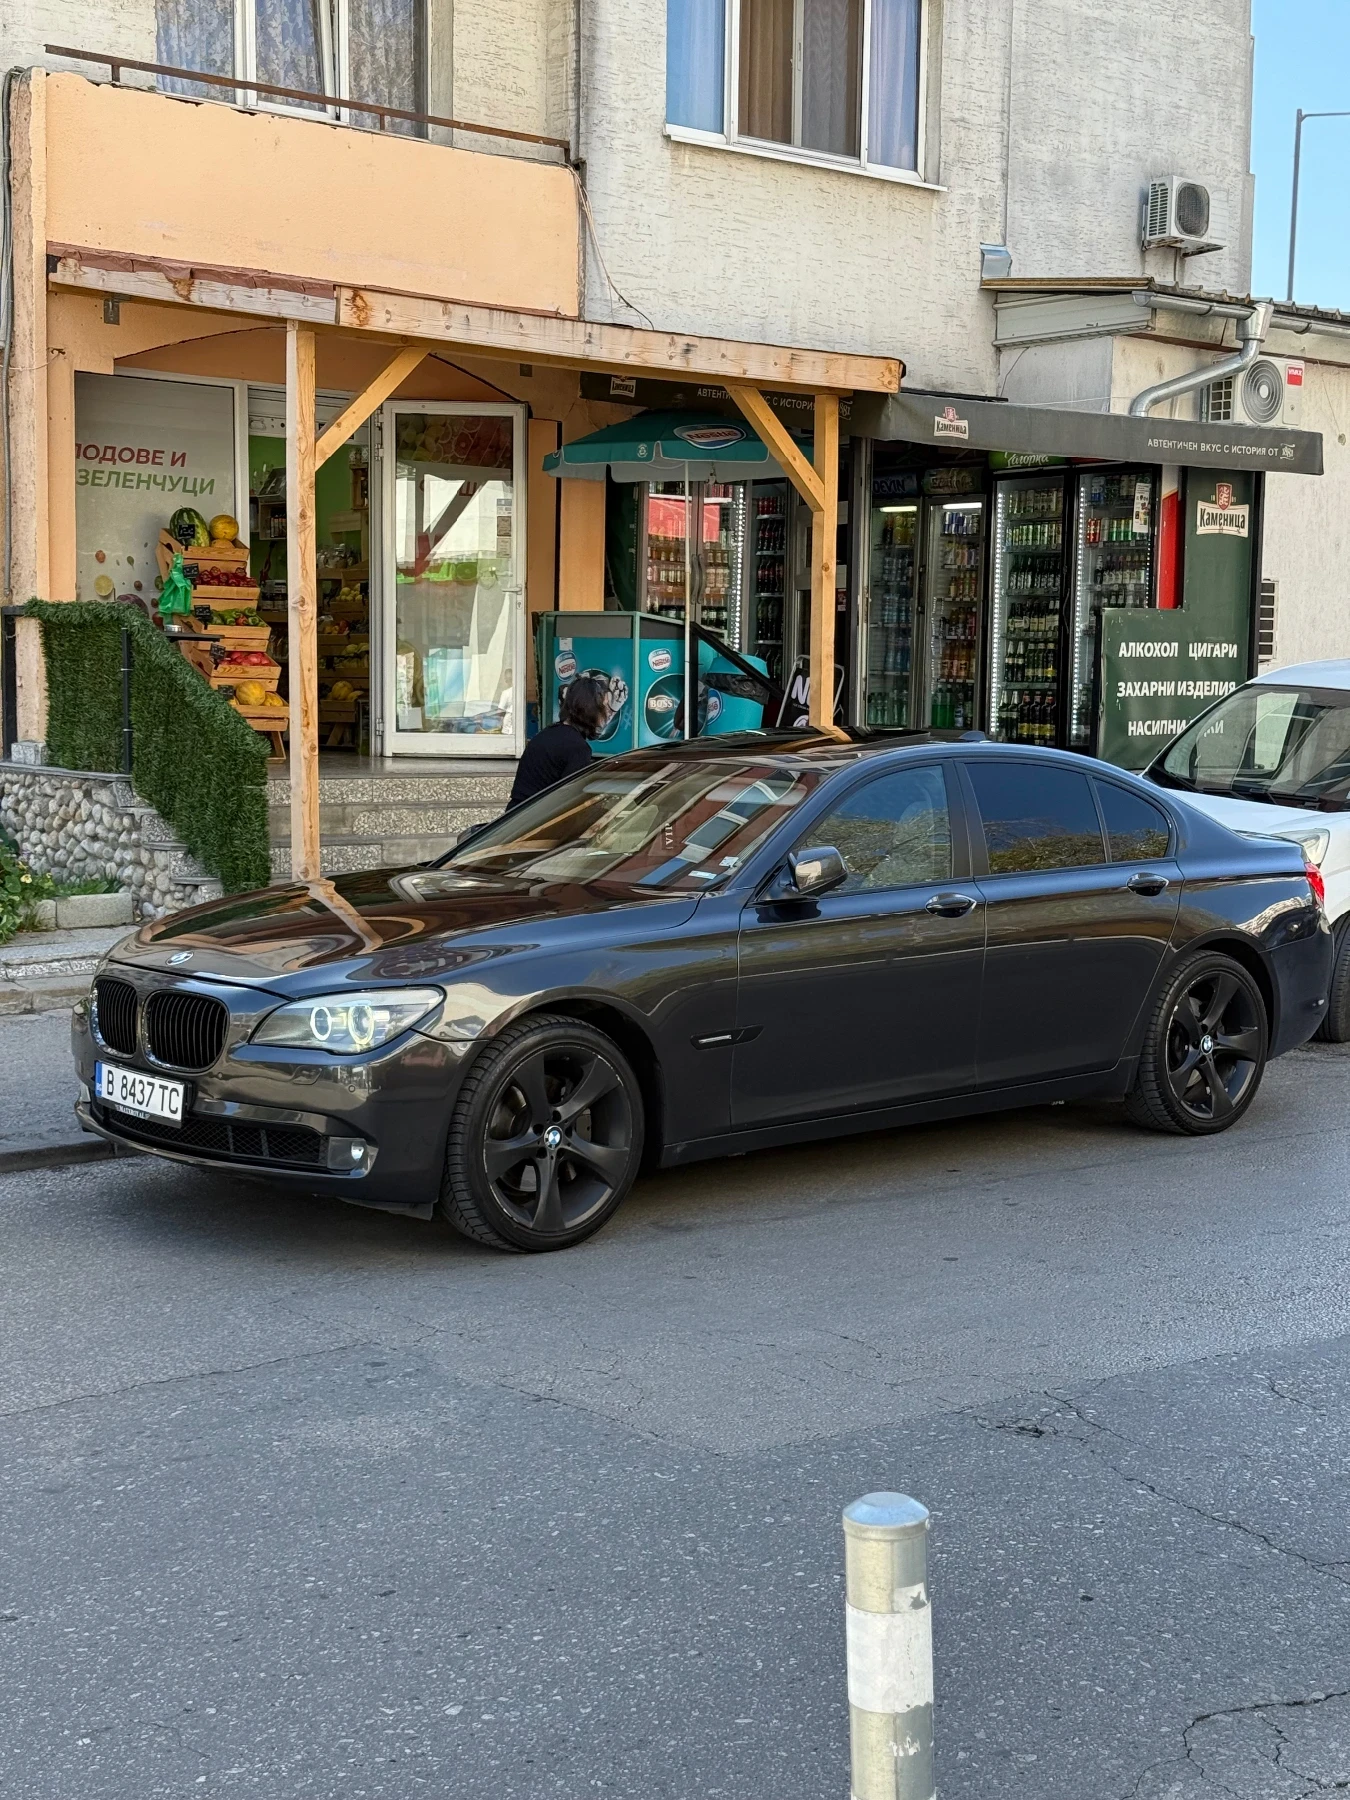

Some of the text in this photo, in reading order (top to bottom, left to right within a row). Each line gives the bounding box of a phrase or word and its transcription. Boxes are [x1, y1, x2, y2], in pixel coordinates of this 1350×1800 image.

[1147, 438, 1198, 451] АВТЕНТИЧЕН
[1200, 442, 1221, 453] ВКУС
[1223, 444, 1230, 453] С
[1231, 445, 1266, 456] ИСТОРИЯ
[1267, 447, 1279, 457] ОТ
[170, 451, 187, 468] И
[76, 468, 216, 498] ЗЕЛЕНЧУЦИ
[1199, 507, 1246, 531] Каменица
[1118, 641, 1238, 661] АЛКОХОЛ ЦИГАРИ
[1116, 681, 1236, 699] ЗАХАРНИ ИЗДЕЛИЯ
[649, 699, 673, 708] BOSS
[1127, 719, 1187, 737] НАСИПНИ
[107, 1070, 114, 1096] B
[120, 1075, 155, 1107] 8437
[159, 1084, 179, 1114] TC
